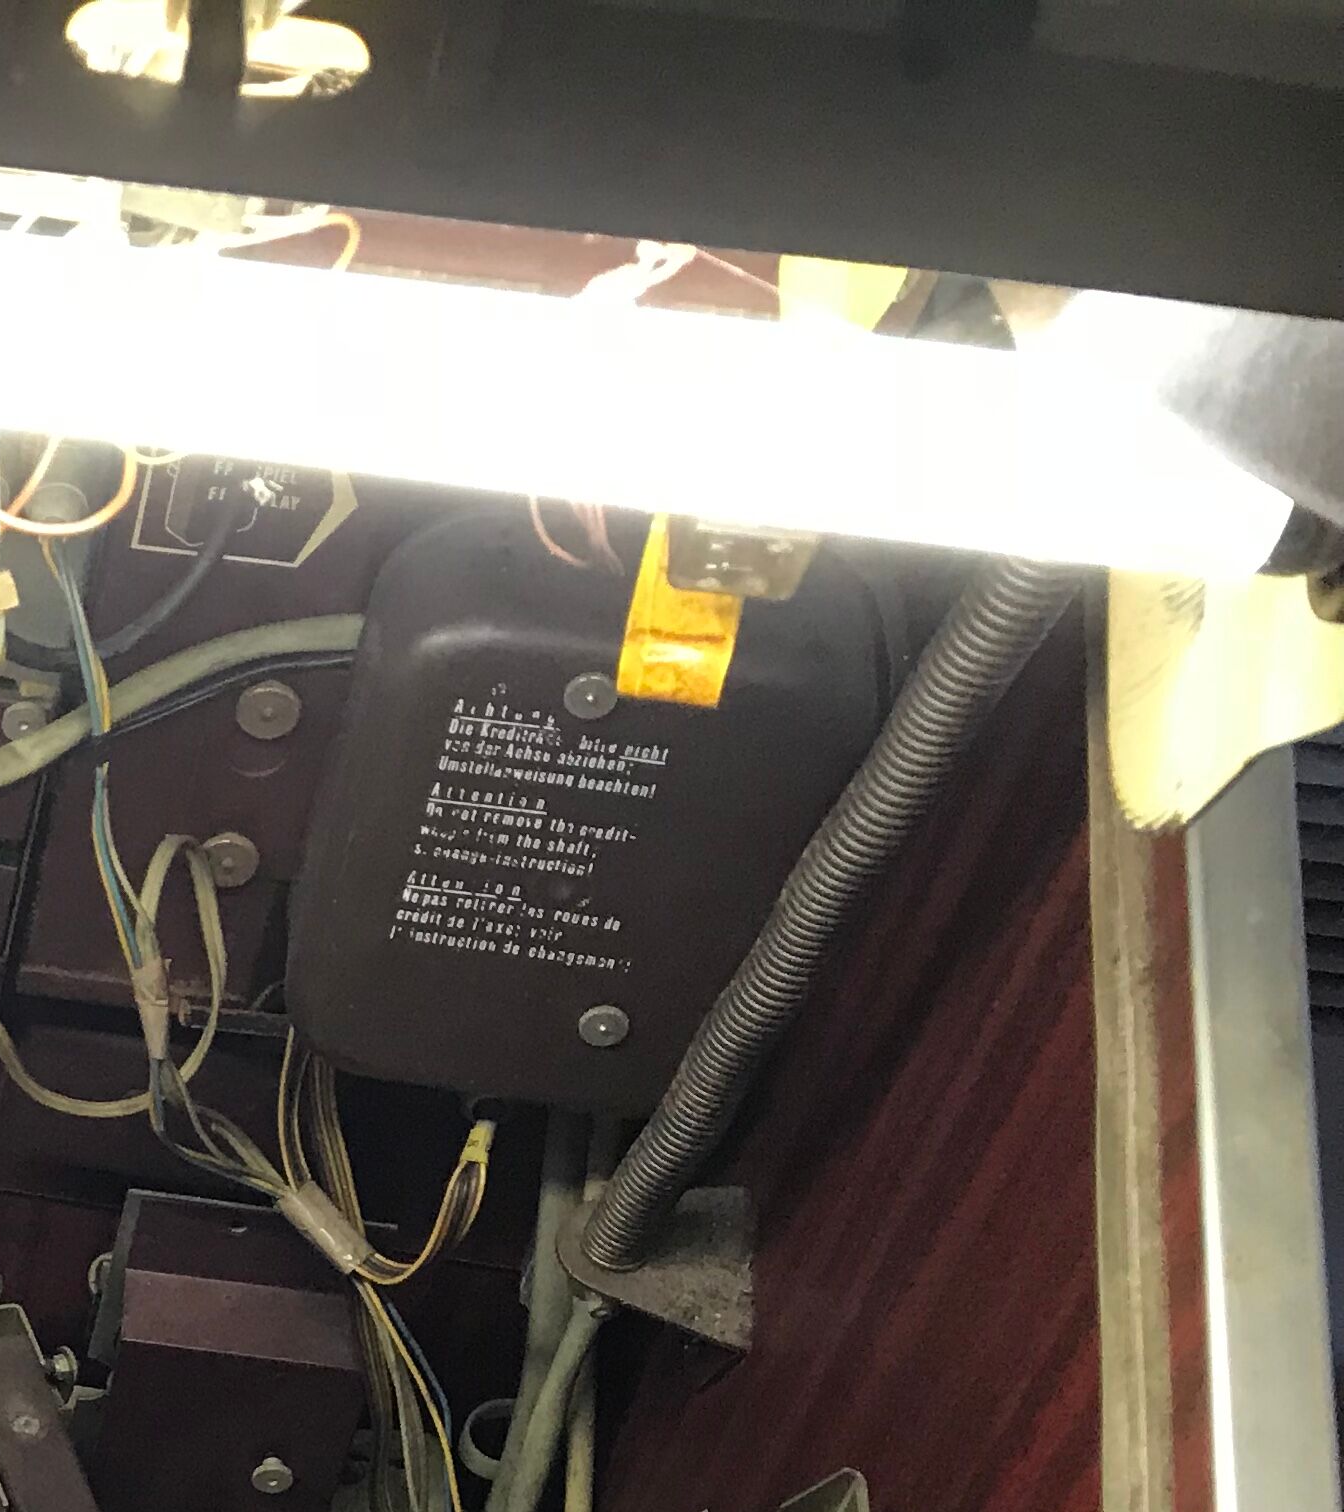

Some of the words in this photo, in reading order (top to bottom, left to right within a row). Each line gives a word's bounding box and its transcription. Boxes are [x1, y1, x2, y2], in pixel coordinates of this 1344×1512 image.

[448, 718, 473, 736] Die
[578, 774, 656, 799] beachten!
[516, 835, 541, 849] the
